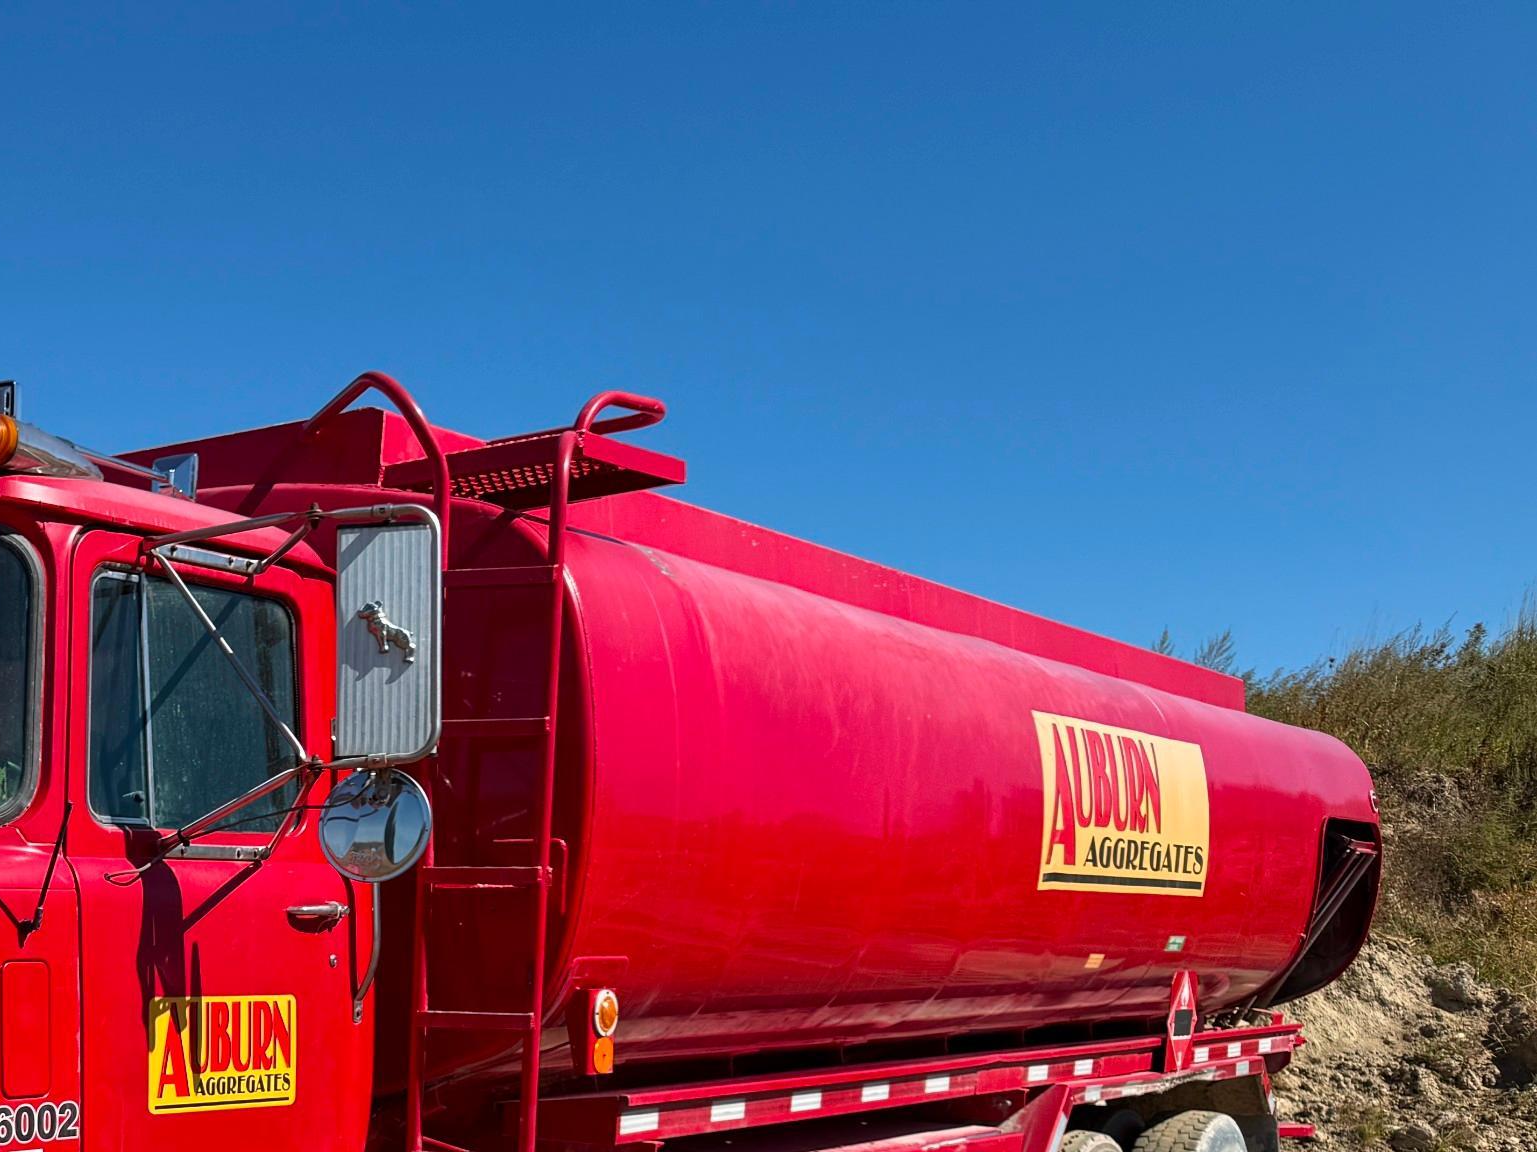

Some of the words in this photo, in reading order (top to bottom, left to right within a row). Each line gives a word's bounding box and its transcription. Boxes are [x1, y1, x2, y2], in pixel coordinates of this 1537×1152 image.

[1045, 723, 1162, 866] AUBURN
[1083, 836, 1204, 875] AGGREGATES
[157, 1000, 291, 1098] AUBURN
[195, 1073, 291, 1096] AGGREGATES
